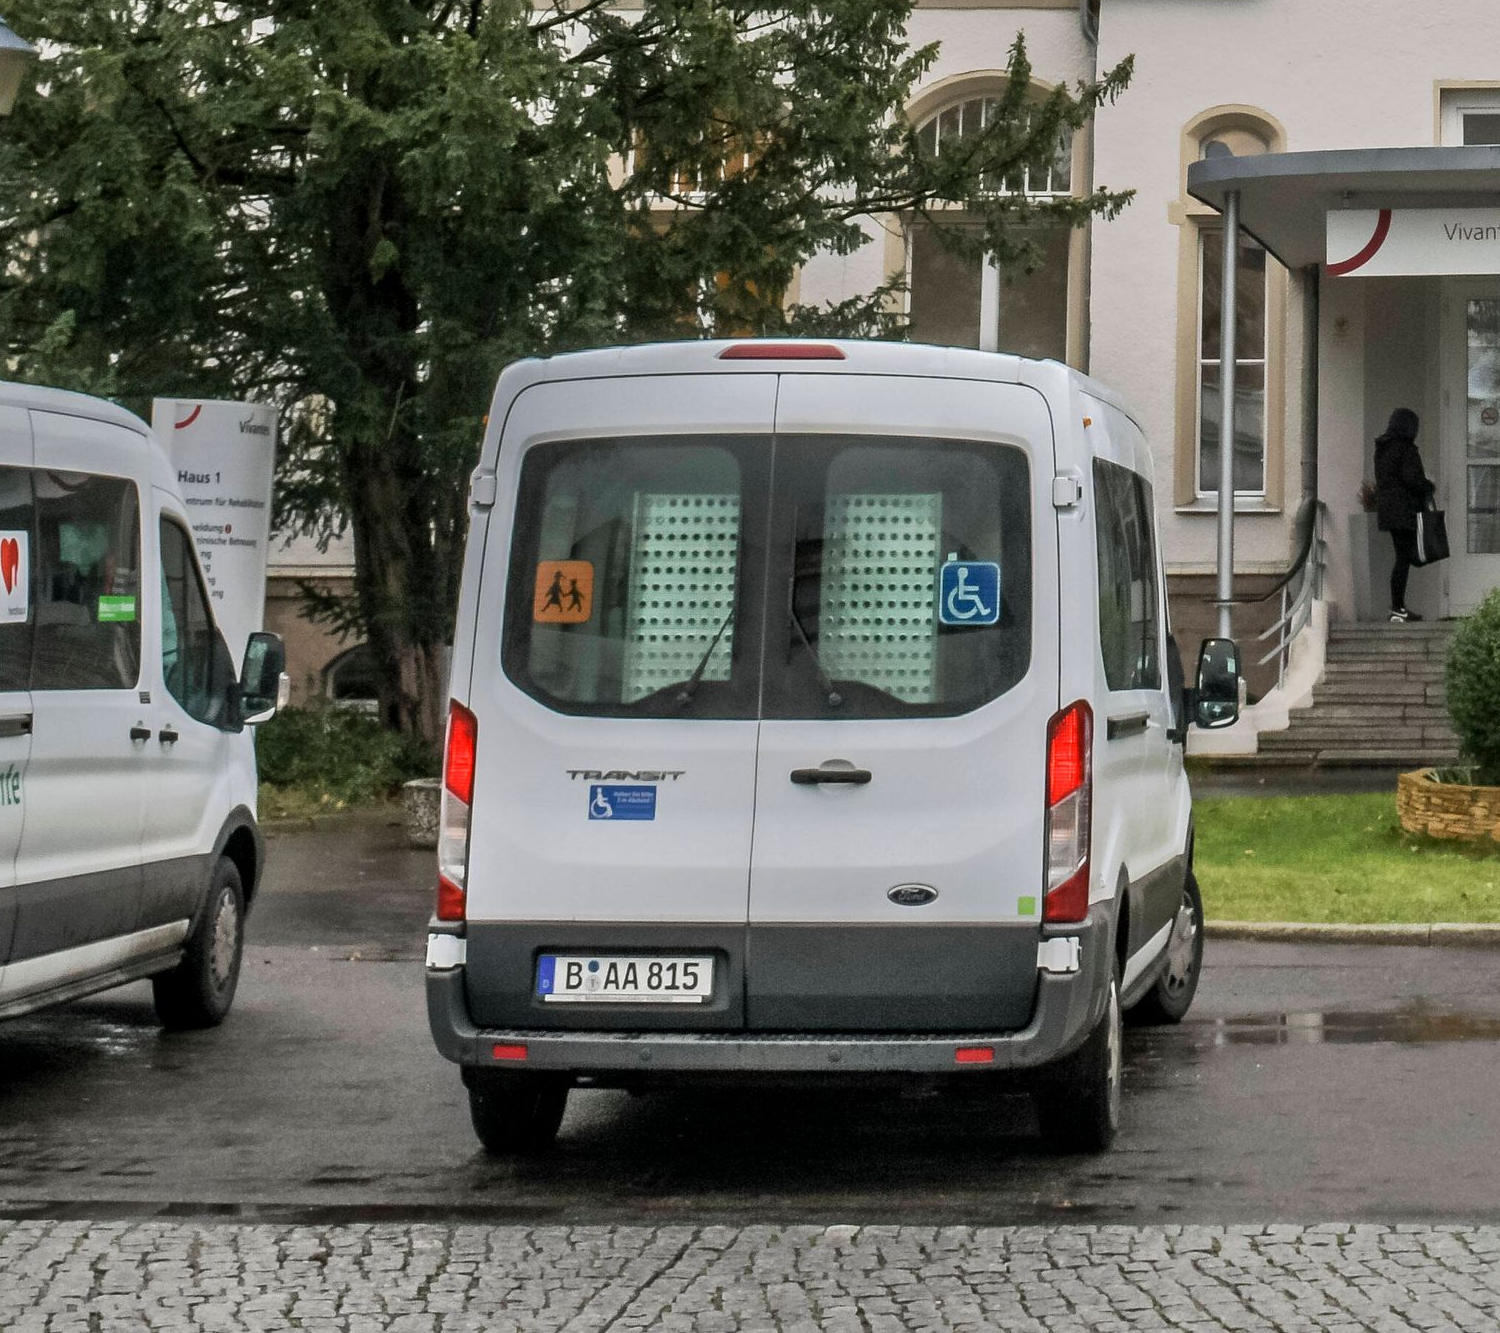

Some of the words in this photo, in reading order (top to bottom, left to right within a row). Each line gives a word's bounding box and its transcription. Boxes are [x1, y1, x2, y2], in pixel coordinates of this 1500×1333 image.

[178, 470, 210, 484] Haus
[215, 471, 220, 484] 1
[566, 770, 686, 782] TRANSIT
[565, 961, 583, 990] B
[603, 961, 639, 990] AA
[646, 962, 700, 991] 815
